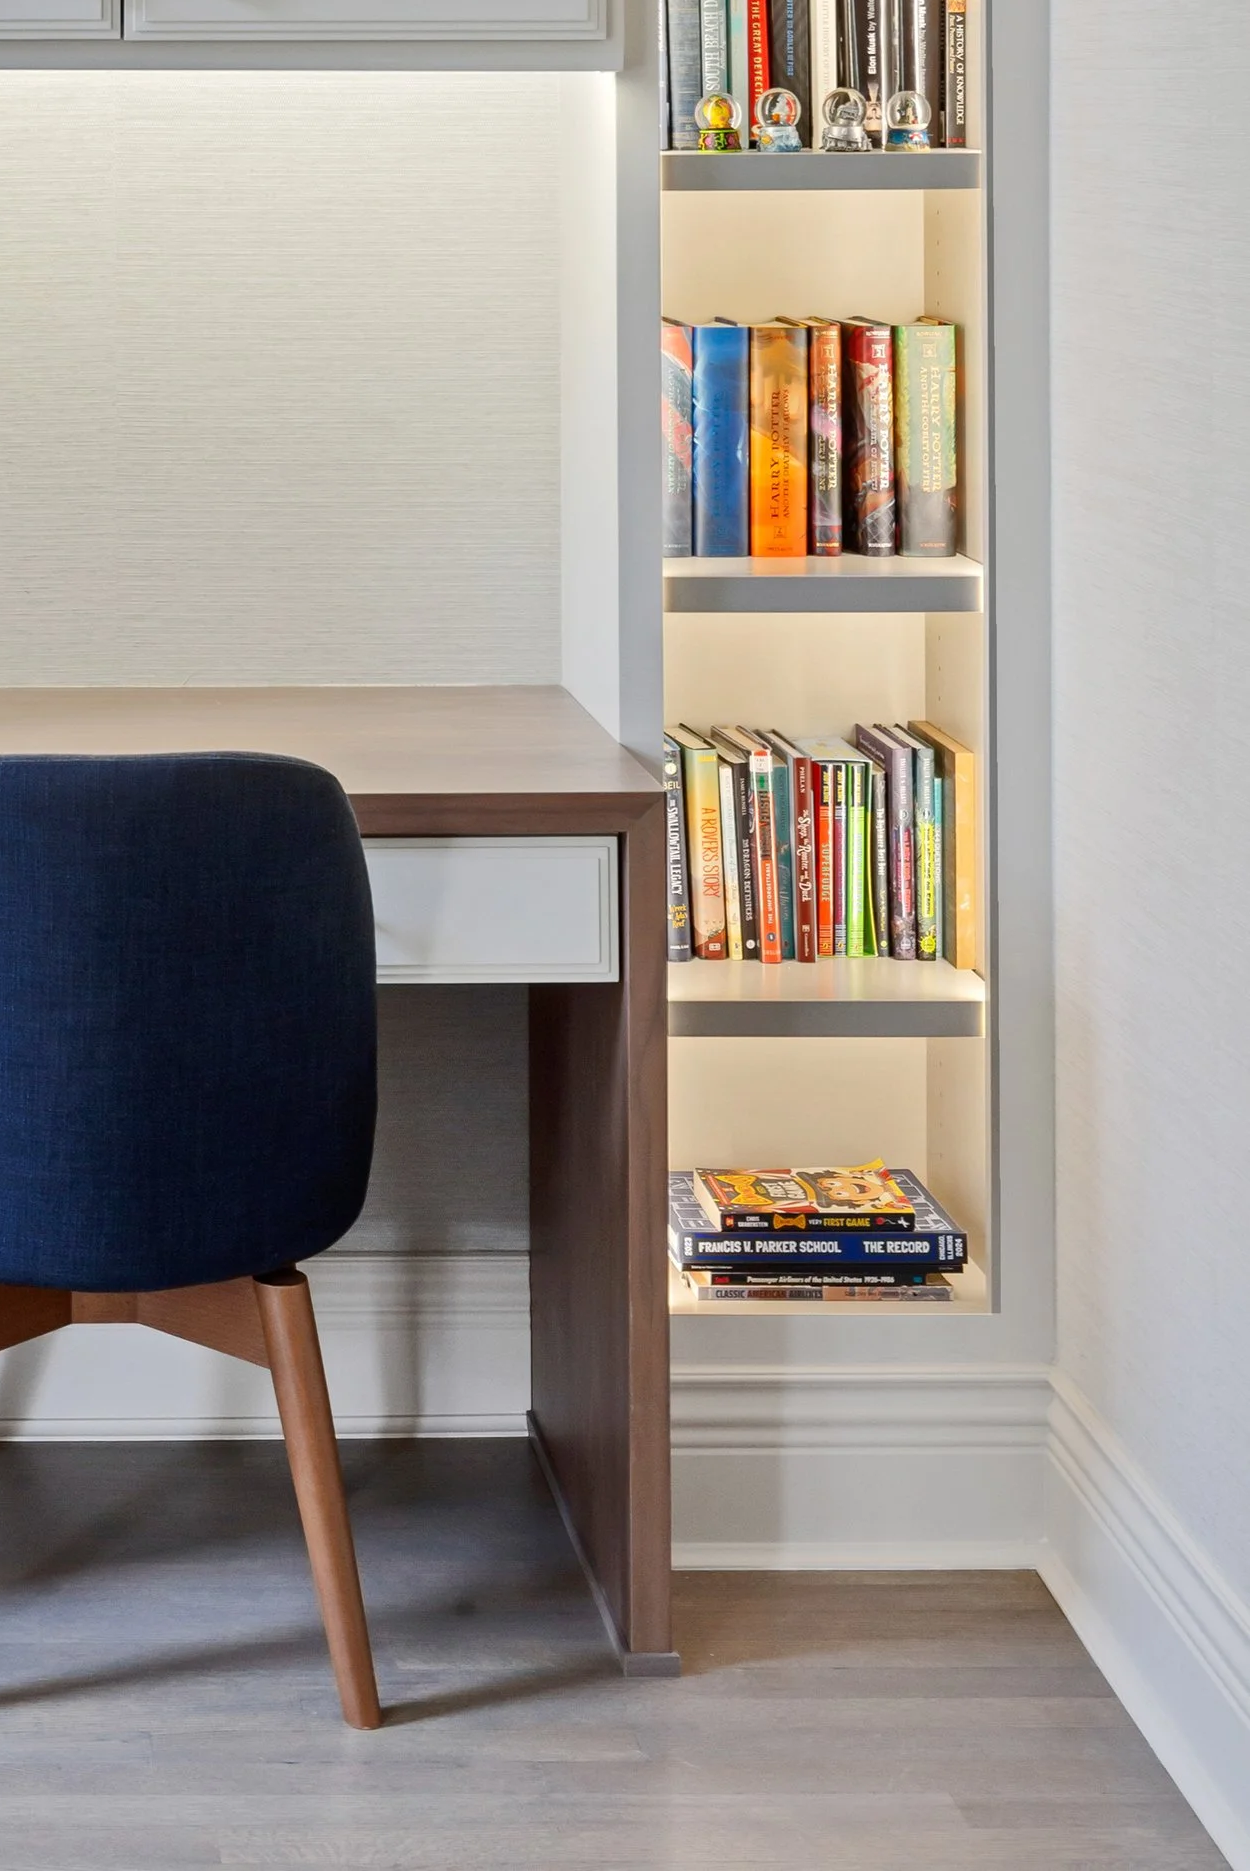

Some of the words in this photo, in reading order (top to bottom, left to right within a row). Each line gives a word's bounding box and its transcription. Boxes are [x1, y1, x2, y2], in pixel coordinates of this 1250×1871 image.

[751, 1, 760, 19] THE
[918, 6, 927, 28] Musk
[704, 11, 720, 49] BEACH
[752, 23, 762, 53] GREAT
[868, 21, 877, 32] by
[868, 32, 876, 55] Musk
[956, 25, 965, 60] HISTORY
[705, 52, 720, 91] SOUTH
[869, 56, 877, 74] Elon
[956, 63, 965, 74] OF
[956, 76, 965, 125] KNOWLEDGE
[920, 366, 929, 389] AND
[827, 363, 838, 425] HARRY
[879, 363, 890, 425] HARRY
[921, 392, 930, 413] THE
[931, 367, 942, 427] HARRY
[770, 390, 781, 450] POTTER
[782, 389, 791, 431] HALLOWS
[921, 416, 930, 451] GOBLET
[782, 434, 791, 477] DEATHLY
[828, 429, 838, 490] POTTER
[879, 429, 890, 490] POTTER
[922, 453, 930, 466] OF
[932, 432, 942, 492] POTTER
[769, 458, 781, 519] HARRY
[782, 480, 791, 496] THE
[922, 469, 931, 493] FIRE
[782, 499, 791, 519] AND
[667, 807, 681, 863] SWALLOWTAIL
[701, 818, 719, 862] ROVER'S
[742, 848, 751, 879] DRAGON
[821, 843, 830, 902] SUPERFUDGE
[670, 864, 683, 895] LEGACY
[703, 865, 720, 898] STORY
[798, 881, 812, 903] Duck
[824, 1217, 844, 1227] FIRST
[846, 1217, 870, 1227] GAME
[684, 1237, 694, 1256] 2023
[698, 1241, 742, 1253] FRANCIS
[744, 1241, 753, 1253] W.
[755, 1241, 797, 1253] PARKER
[799, 1241, 842, 1253] SCHOOL
[863, 1241, 885, 1253] THE
[887, 1241, 930, 1253] RECORD
[938, 1234, 946, 1260] CHICAGO,
[946, 1235, 954, 1260] ILLINOIS
[955, 1238, 963, 1257] 2024
[715, 1290, 745, 1299] CLASSIC
[747, 1290, 787, 1299] AMERICAN
[789, 1290, 823, 1299] AIRLINES
[747, 1276, 778, 1284] Passenger
